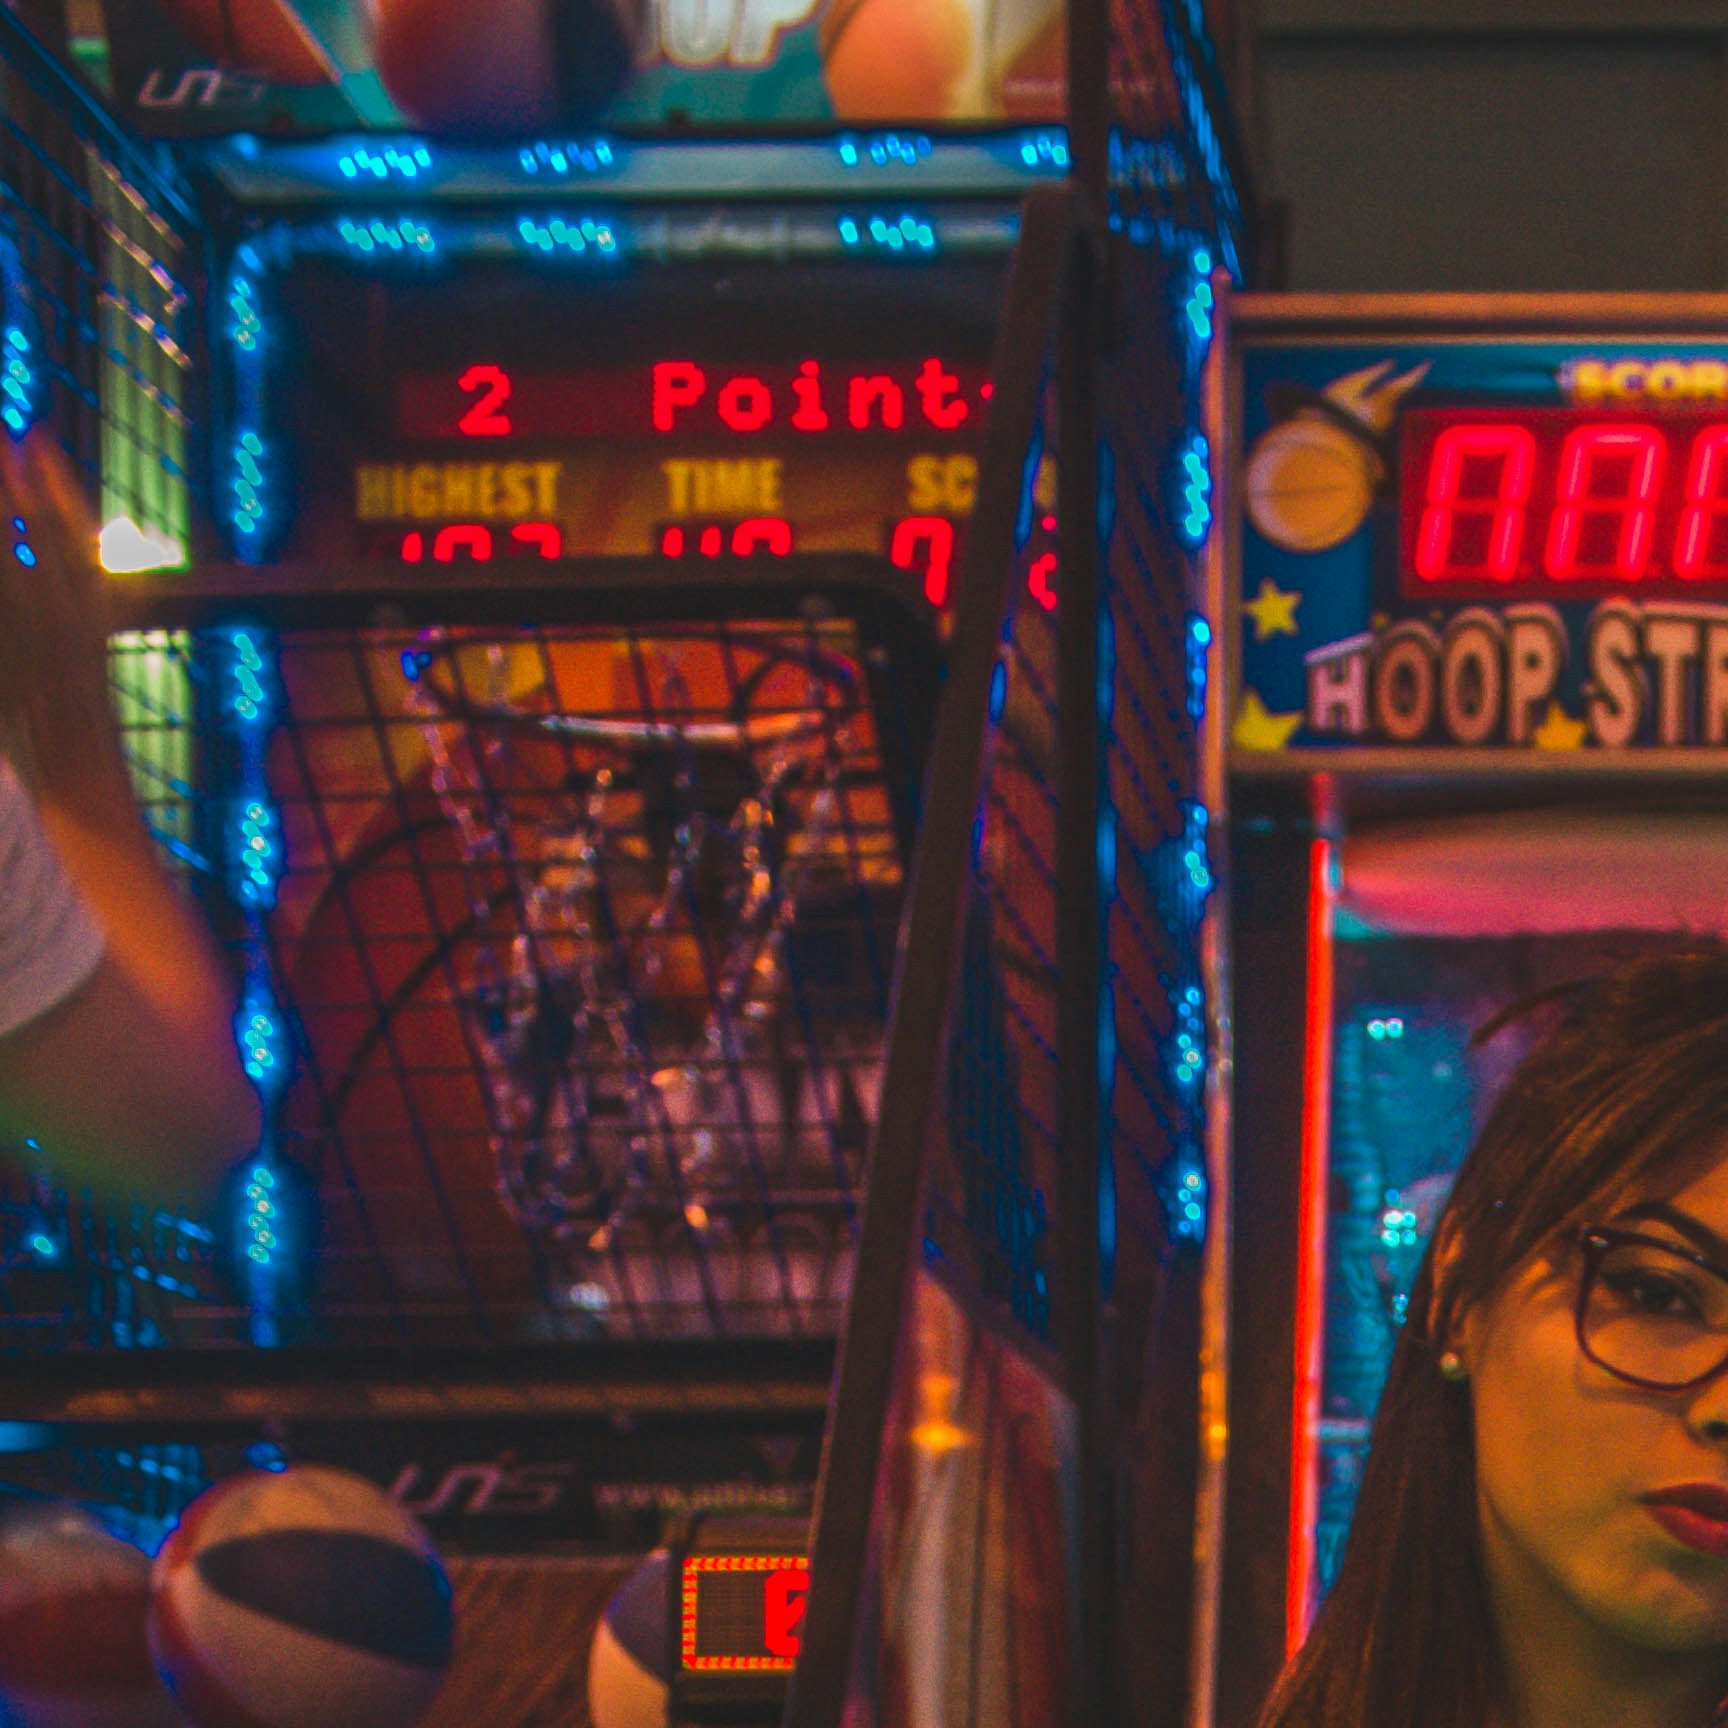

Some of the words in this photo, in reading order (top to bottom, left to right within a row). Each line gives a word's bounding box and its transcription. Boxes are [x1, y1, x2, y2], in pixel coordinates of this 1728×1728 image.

[457, 364, 511, 436] 2
[652, 358, 993, 432] Point
[356, 460, 562, 520] HIGHEST
[662, 457, 783, 512] TIME
[1304, 604, 1566, 744] HOOP
